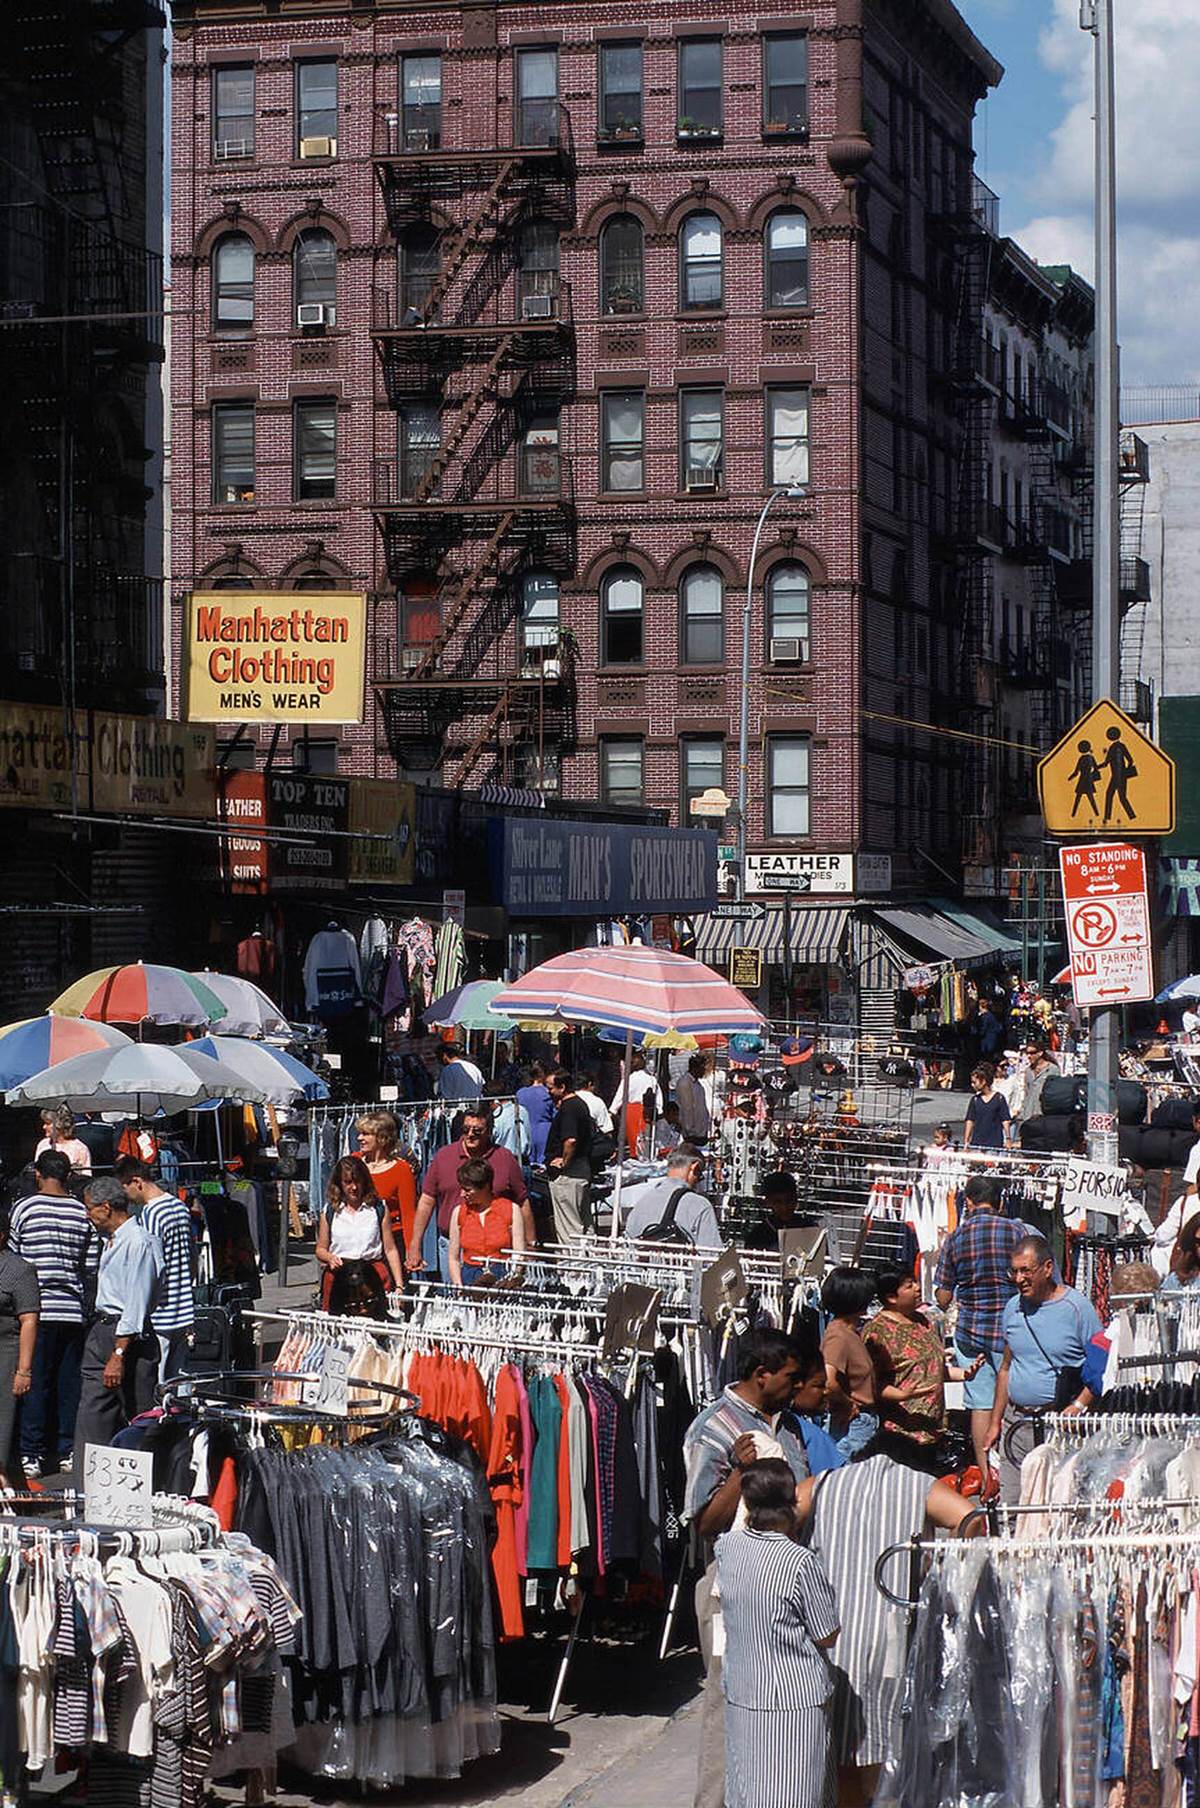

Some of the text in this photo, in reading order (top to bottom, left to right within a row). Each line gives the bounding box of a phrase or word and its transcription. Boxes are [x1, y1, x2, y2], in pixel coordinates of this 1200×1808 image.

[197, 606, 349, 643] Manhattan
[208, 647, 335, 695] Clothing
[219, 691, 321, 709] MEN'S WEAR
[98, 721, 186, 797] Clothing
[272, 779, 346, 807] TOP TEN
[216, 798, 262, 816] LATHER
[630, 838, 706, 900] SPORTSWEAR
[748, 857, 840, 870] LEATHER
[1066, 849, 1139, 866] NO STANDING
[233, 865, 262, 880] SUITS
[767, 878, 805, 887] ONE WAY
[1074, 951, 1143, 974] NO PARKING
[1065, 1168, 1078, 1191] 3
